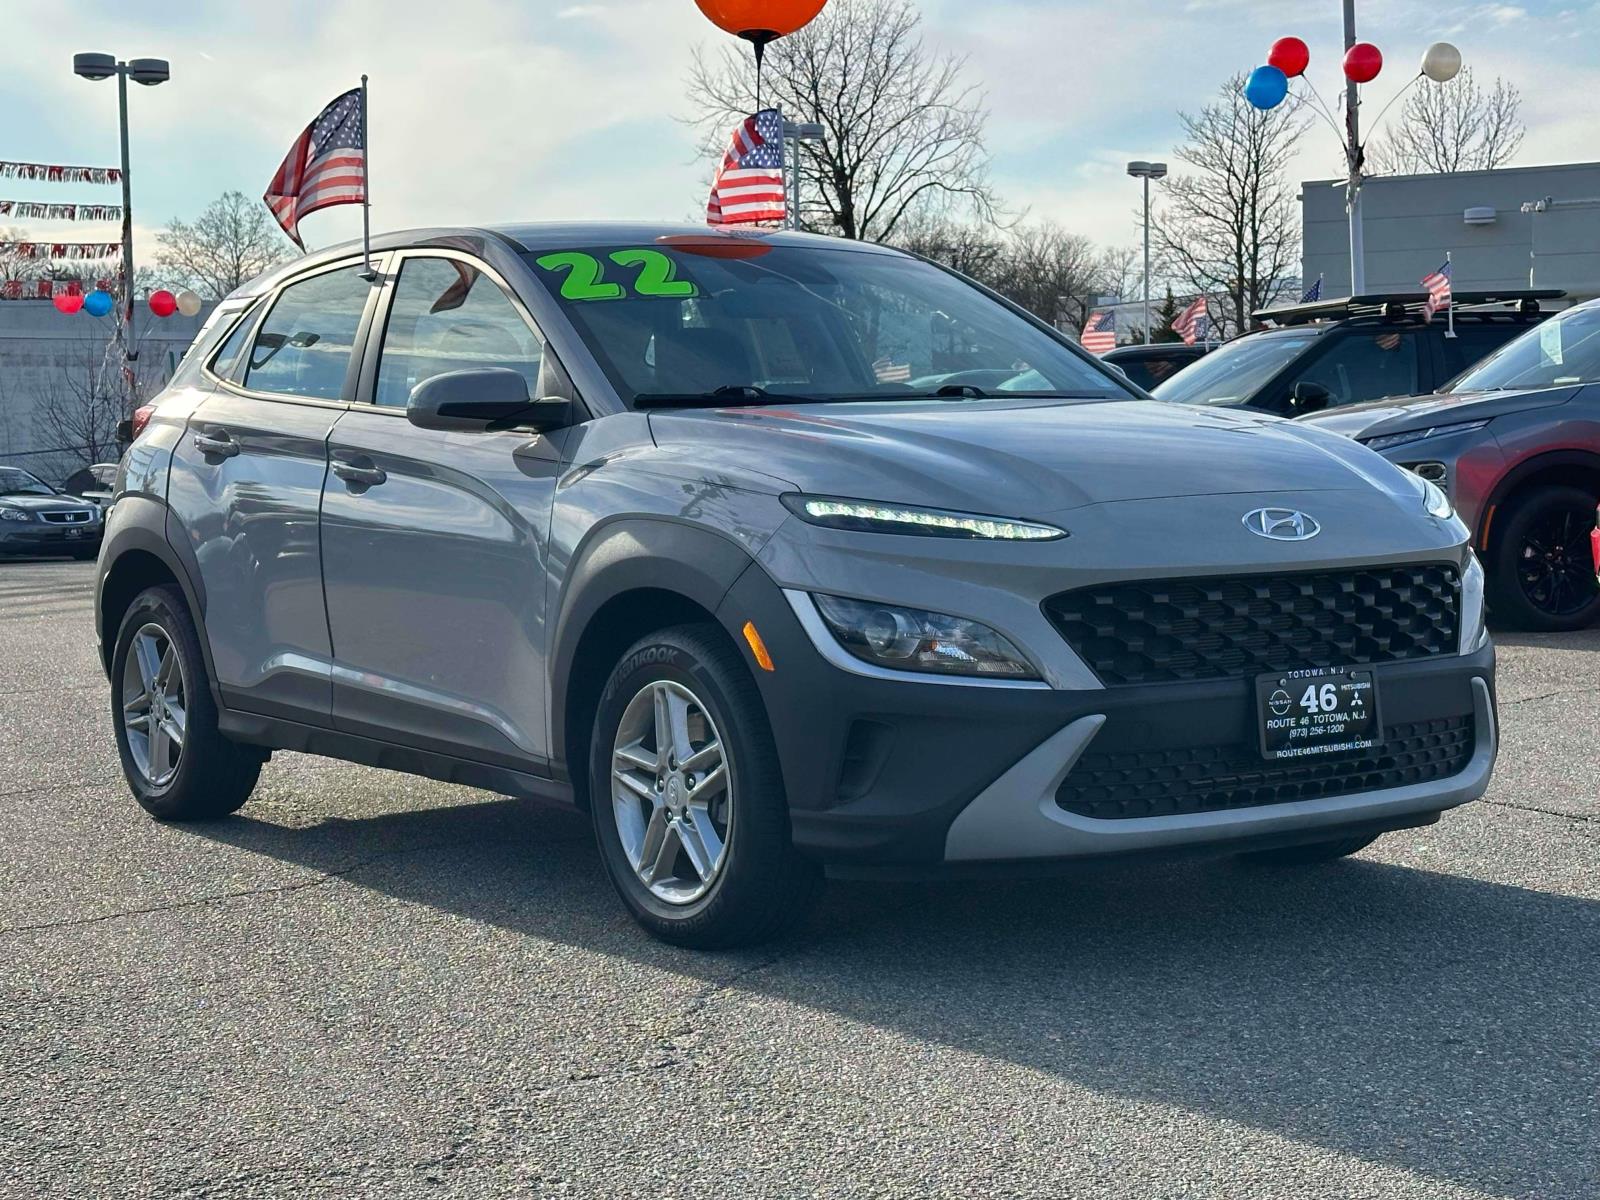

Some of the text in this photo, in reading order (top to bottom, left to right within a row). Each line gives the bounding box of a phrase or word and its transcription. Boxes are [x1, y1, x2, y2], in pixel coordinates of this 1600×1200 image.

[536, 249, 699, 300] 22
[1299, 683, 1338, 713] 46
[1267, 717, 1296, 729] ROUTE
[1299, 716, 1310, 725] 46
[1352, 710, 1368, 720] N.J.
[1289, 724, 1345, 739] (973) 256-1200
[1276, 740, 1372, 758] ROUTE46MITSUBISHI.COM
